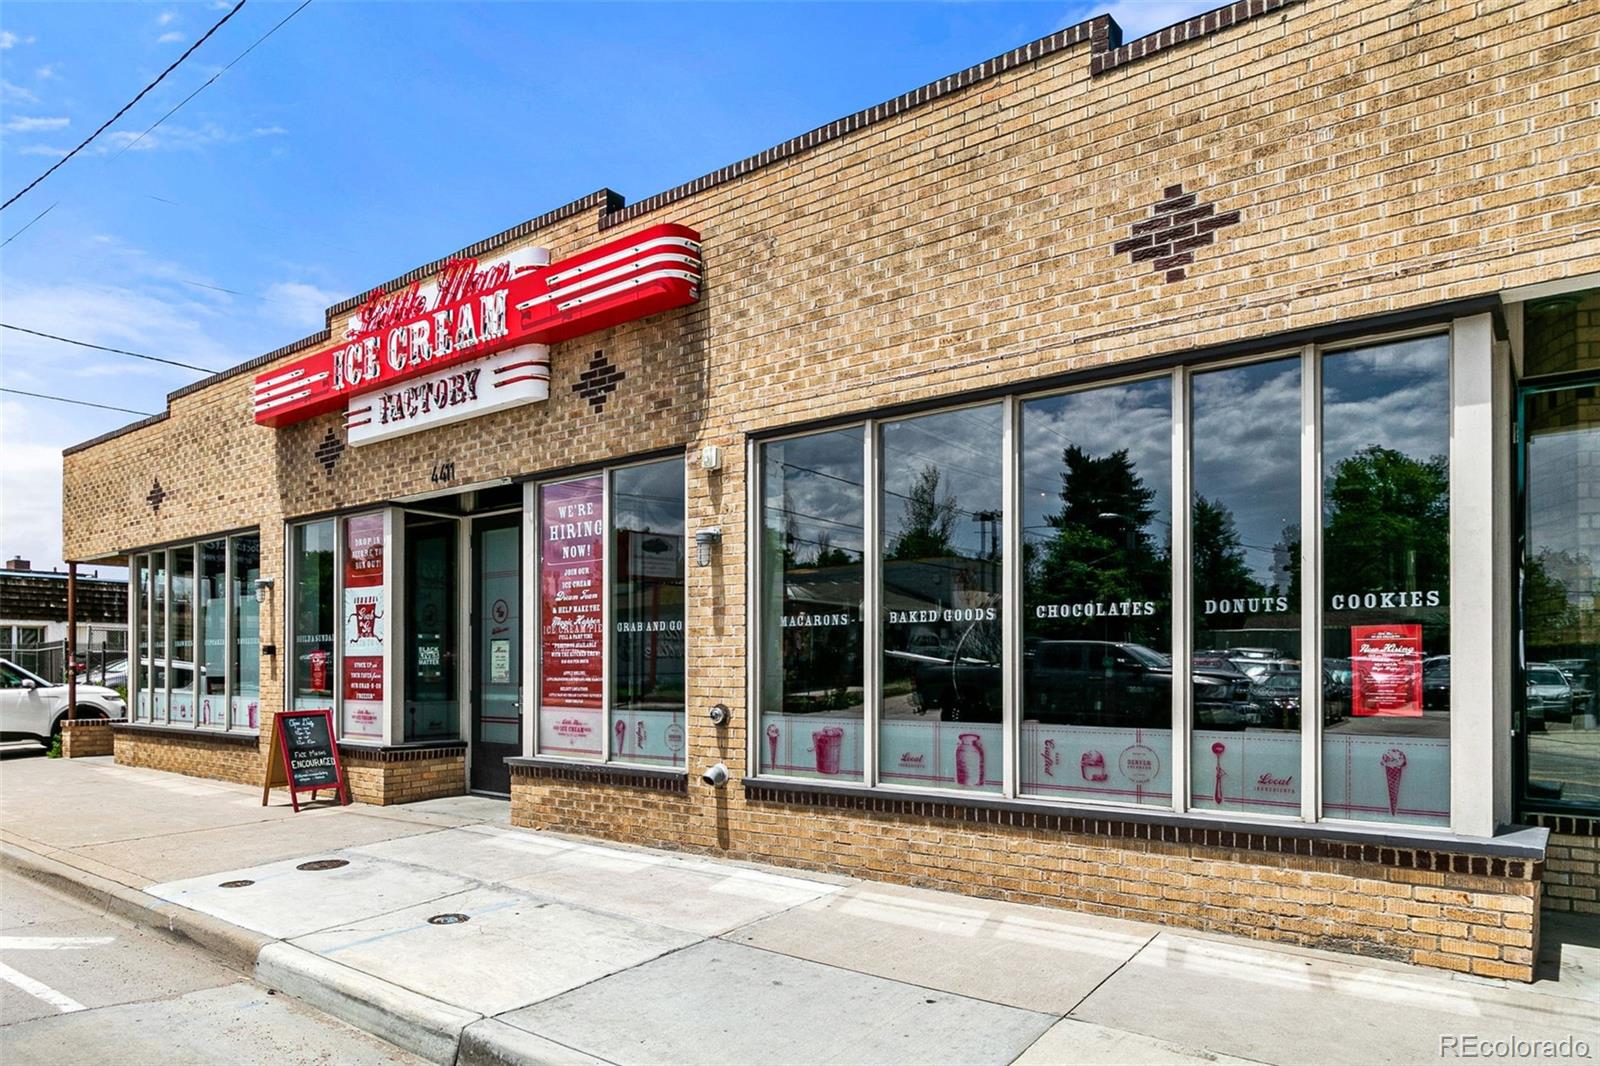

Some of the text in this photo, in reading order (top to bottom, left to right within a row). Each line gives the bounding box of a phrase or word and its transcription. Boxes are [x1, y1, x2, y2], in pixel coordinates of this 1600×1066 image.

[332, 288, 509, 391] ICE CREAM
[379, 367, 482, 425] FACTORY
[431, 462, 455, 484] 4411
[558, 502, 594, 519] WE'RE
[549, 519, 602, 541] HIRING
[562, 544, 591, 559] NOW!
[564, 567, 590, 576] JOIN OUR
[561, 579, 591, 589] ICE CREAM
[554, 589, 598, 601] Dream Team
[1331, 590, 1440, 610] COOKIES
[558, 605, 572, 613] HELP
[589, 604, 600, 612] THE
[1036, 601, 1156, 618] CHOCOLATES
[1204, 597, 1288, 614] DONUTS
[779, 613, 848, 627] MACARONS
[889, 607, 995, 624] BAKED GOODS
[617, 620, 682, 632] GRAB AND GO
[1360, 643, 1414, 656] Now Hiring
[291, 757, 336, 769] ENCOURAGED
[1257, 772, 1292, 785] Local
